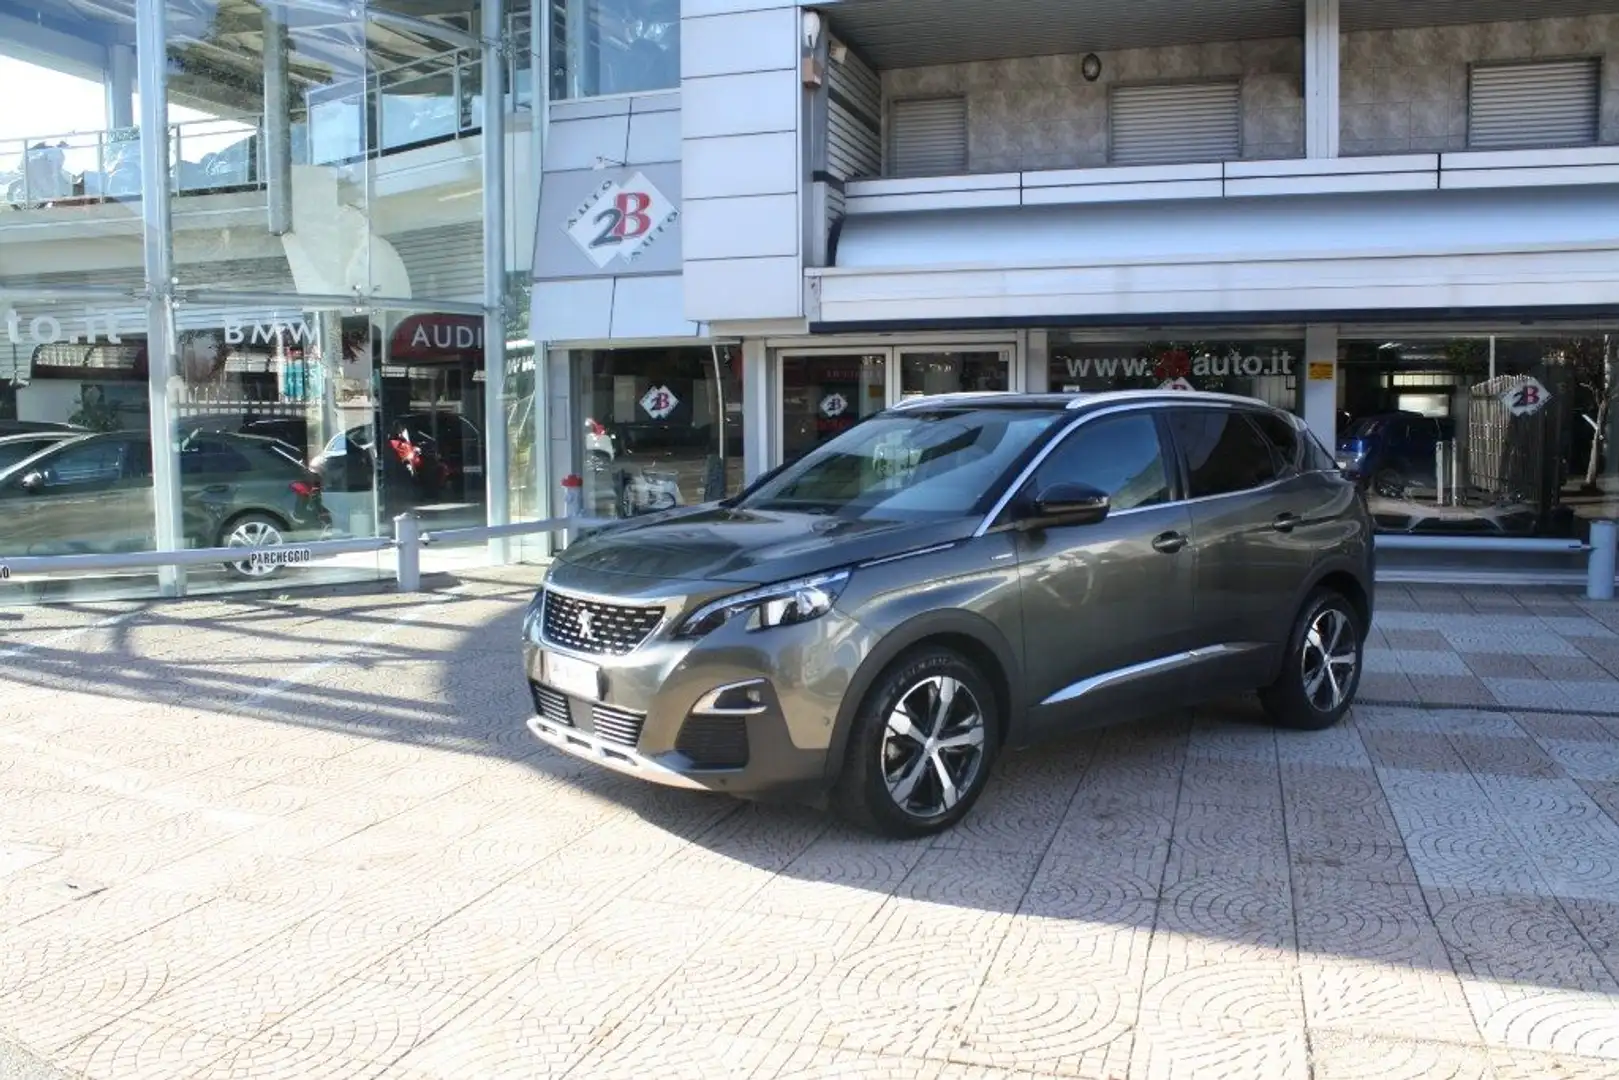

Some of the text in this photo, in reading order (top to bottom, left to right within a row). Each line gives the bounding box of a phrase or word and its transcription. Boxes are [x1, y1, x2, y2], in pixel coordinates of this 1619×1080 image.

[588, 192, 652, 249] 2B
[223, 318, 321, 345] BMW
[410, 322, 484, 349] AUDI
[1066, 350, 1293, 379] www.auto.it
[251, 549, 311, 564] PARCHEGGIO
